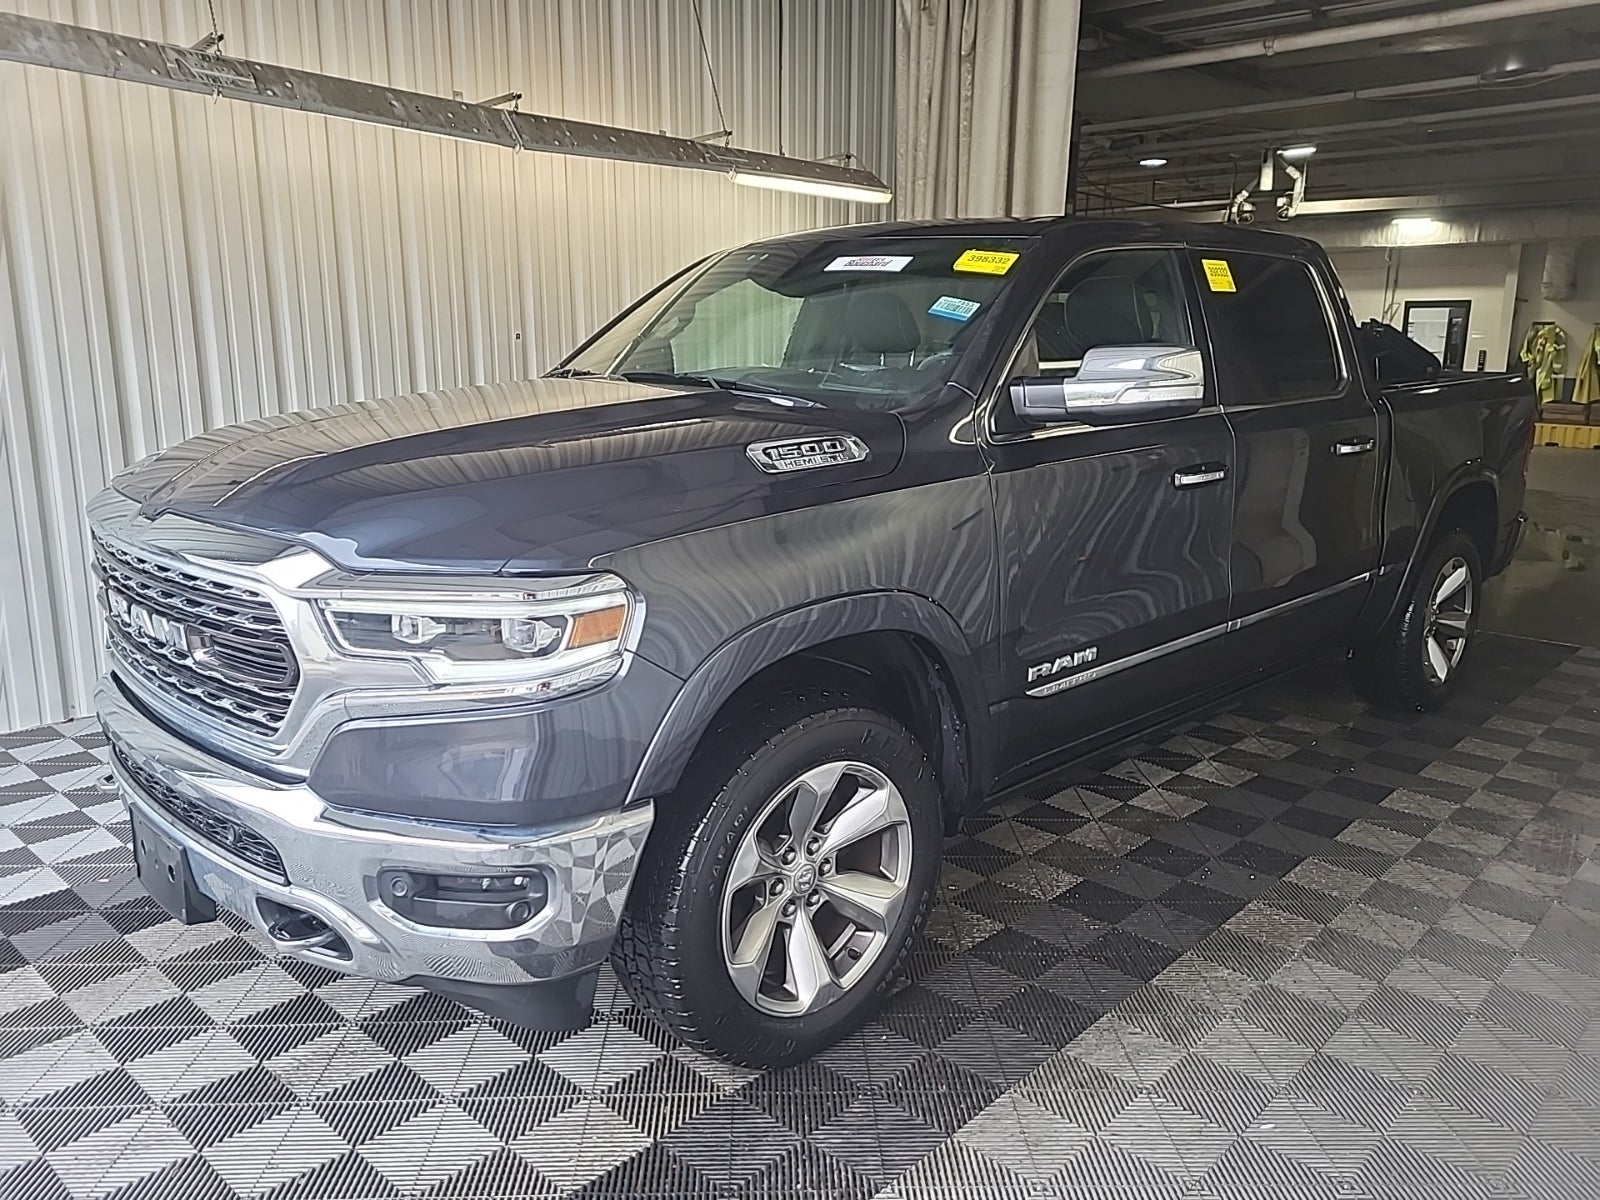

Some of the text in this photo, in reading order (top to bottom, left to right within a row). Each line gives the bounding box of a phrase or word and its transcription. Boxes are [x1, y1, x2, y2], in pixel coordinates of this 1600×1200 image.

[967, 253, 1011, 265] 398332
[765, 440, 846, 461] 1500
[783, 455, 820, 470] HEMI
[107, 588, 188, 652] RAM
[1027, 646, 1098, 683] RAM
